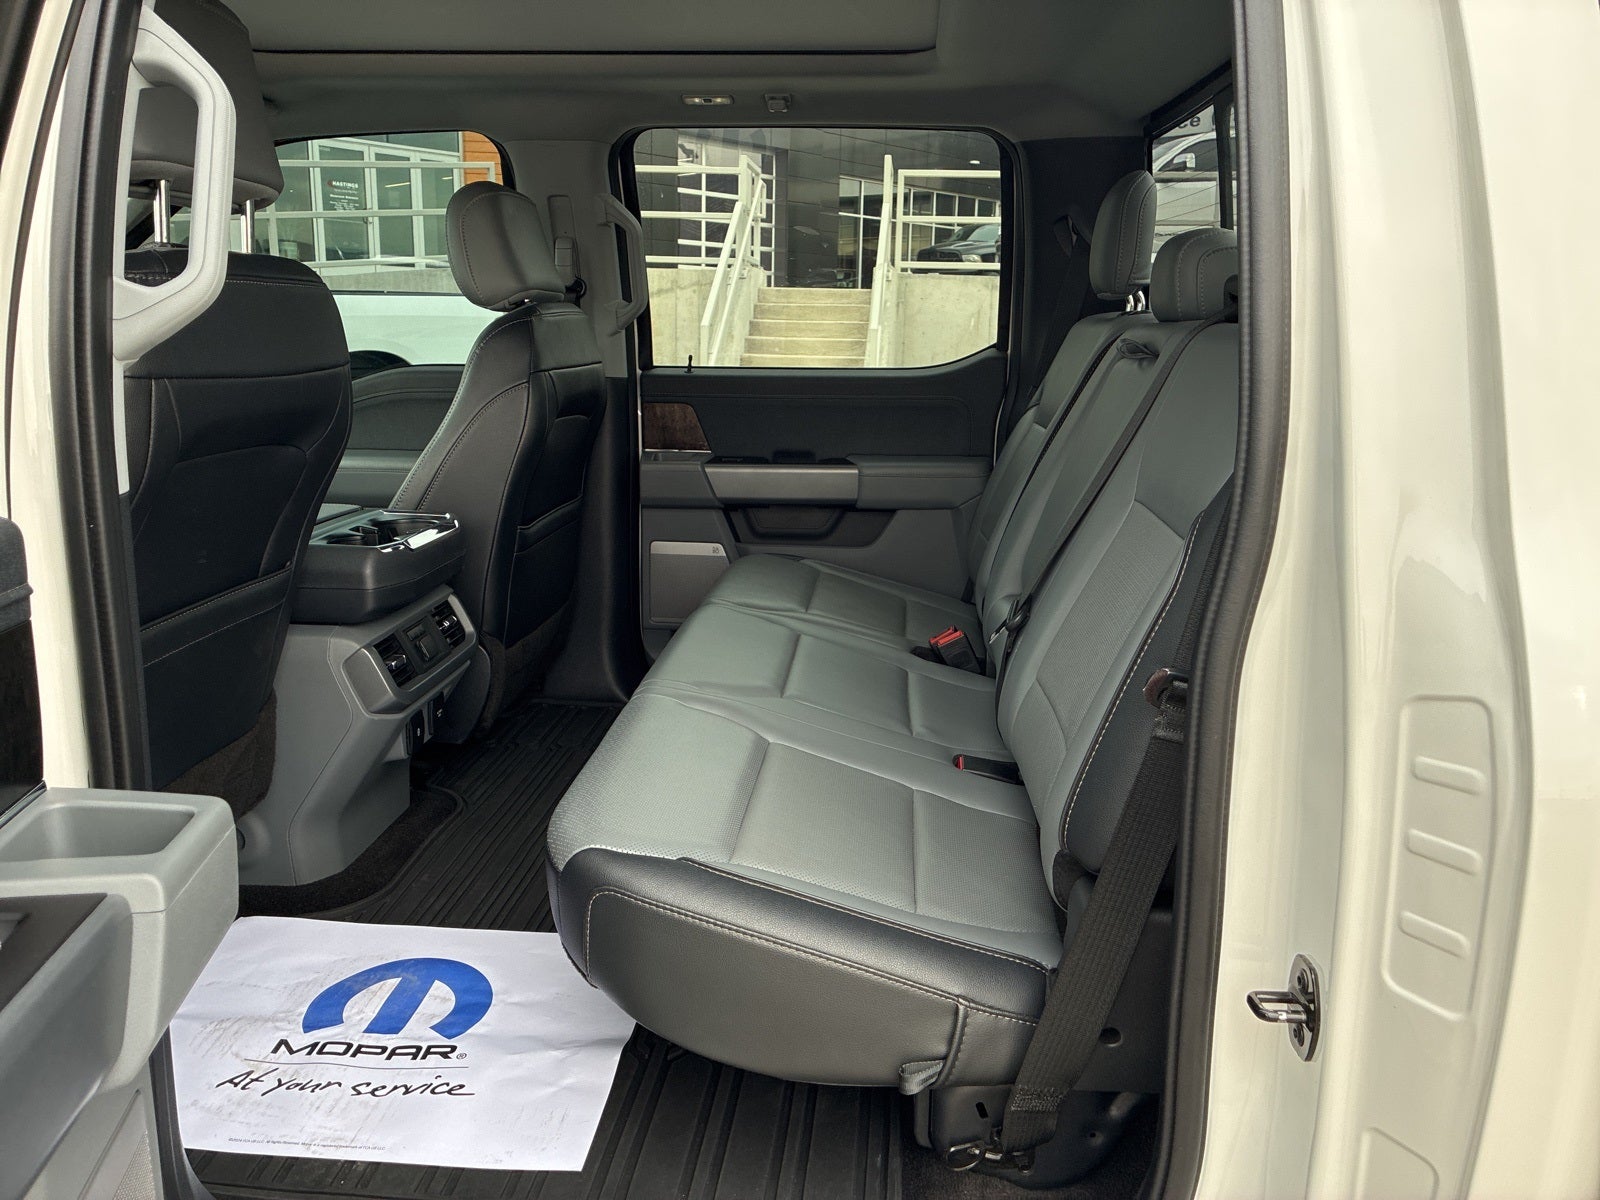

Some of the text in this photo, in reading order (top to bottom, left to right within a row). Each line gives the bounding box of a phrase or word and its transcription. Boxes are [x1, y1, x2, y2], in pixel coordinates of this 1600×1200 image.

[332, 181, 359, 189] HASTINGS
[215, 1068, 475, 1097] At your service
